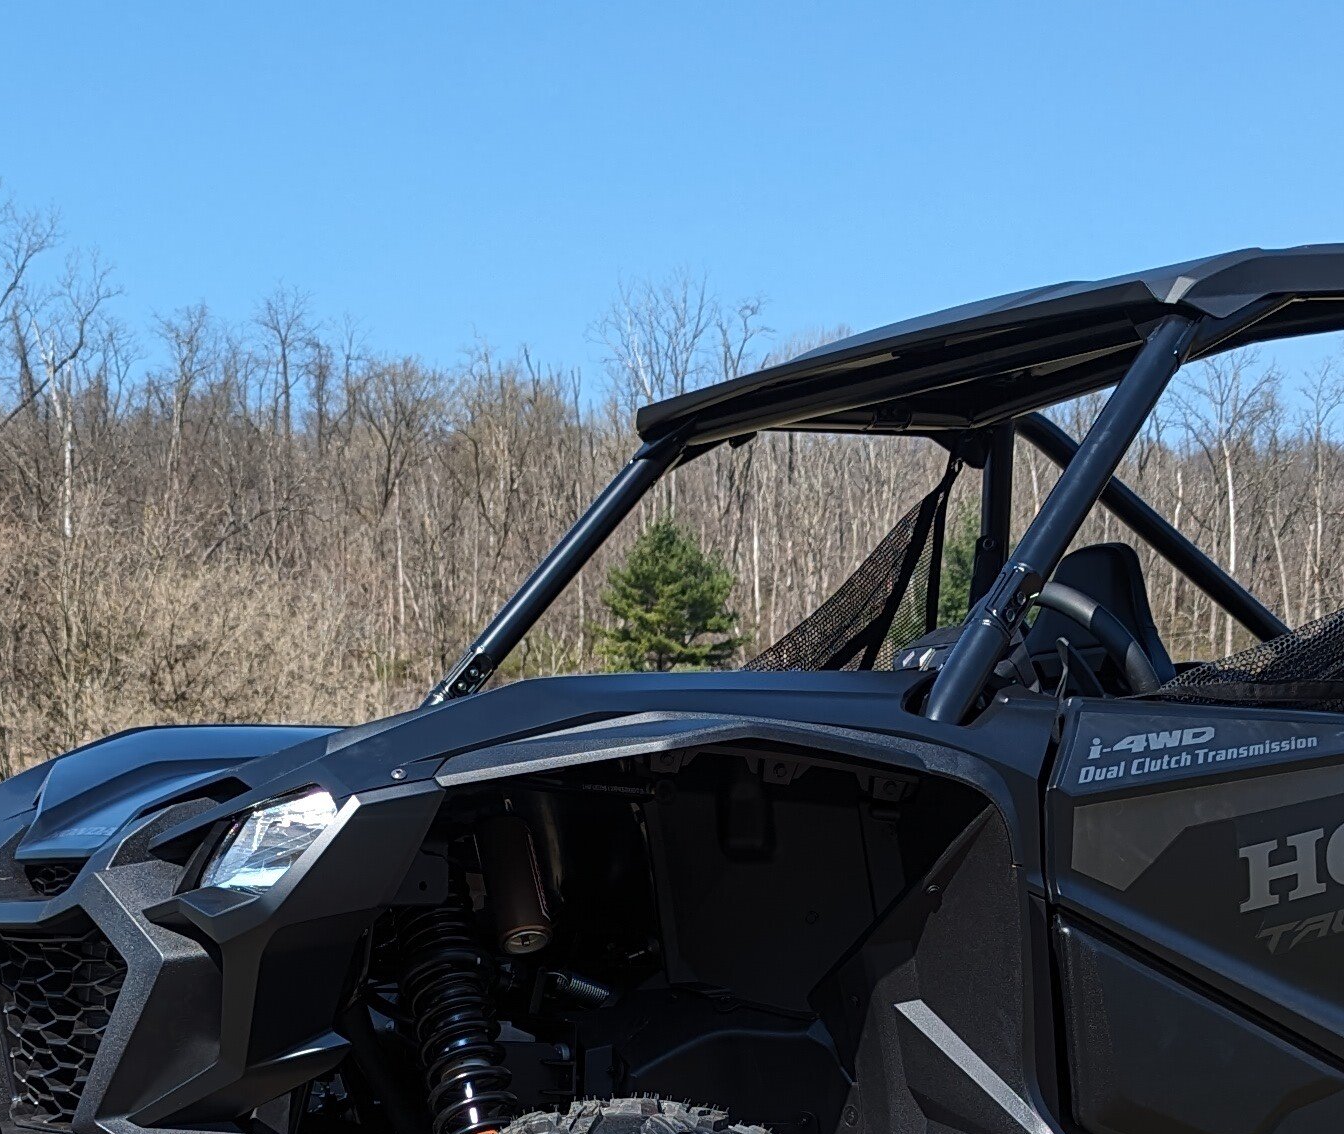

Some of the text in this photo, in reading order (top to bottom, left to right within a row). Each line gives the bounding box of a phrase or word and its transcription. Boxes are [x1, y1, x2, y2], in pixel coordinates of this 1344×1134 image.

[1077, 735, 1319, 785] Dual Clutch Transmission
[1087, 726, 1215, 760] i-4WD
